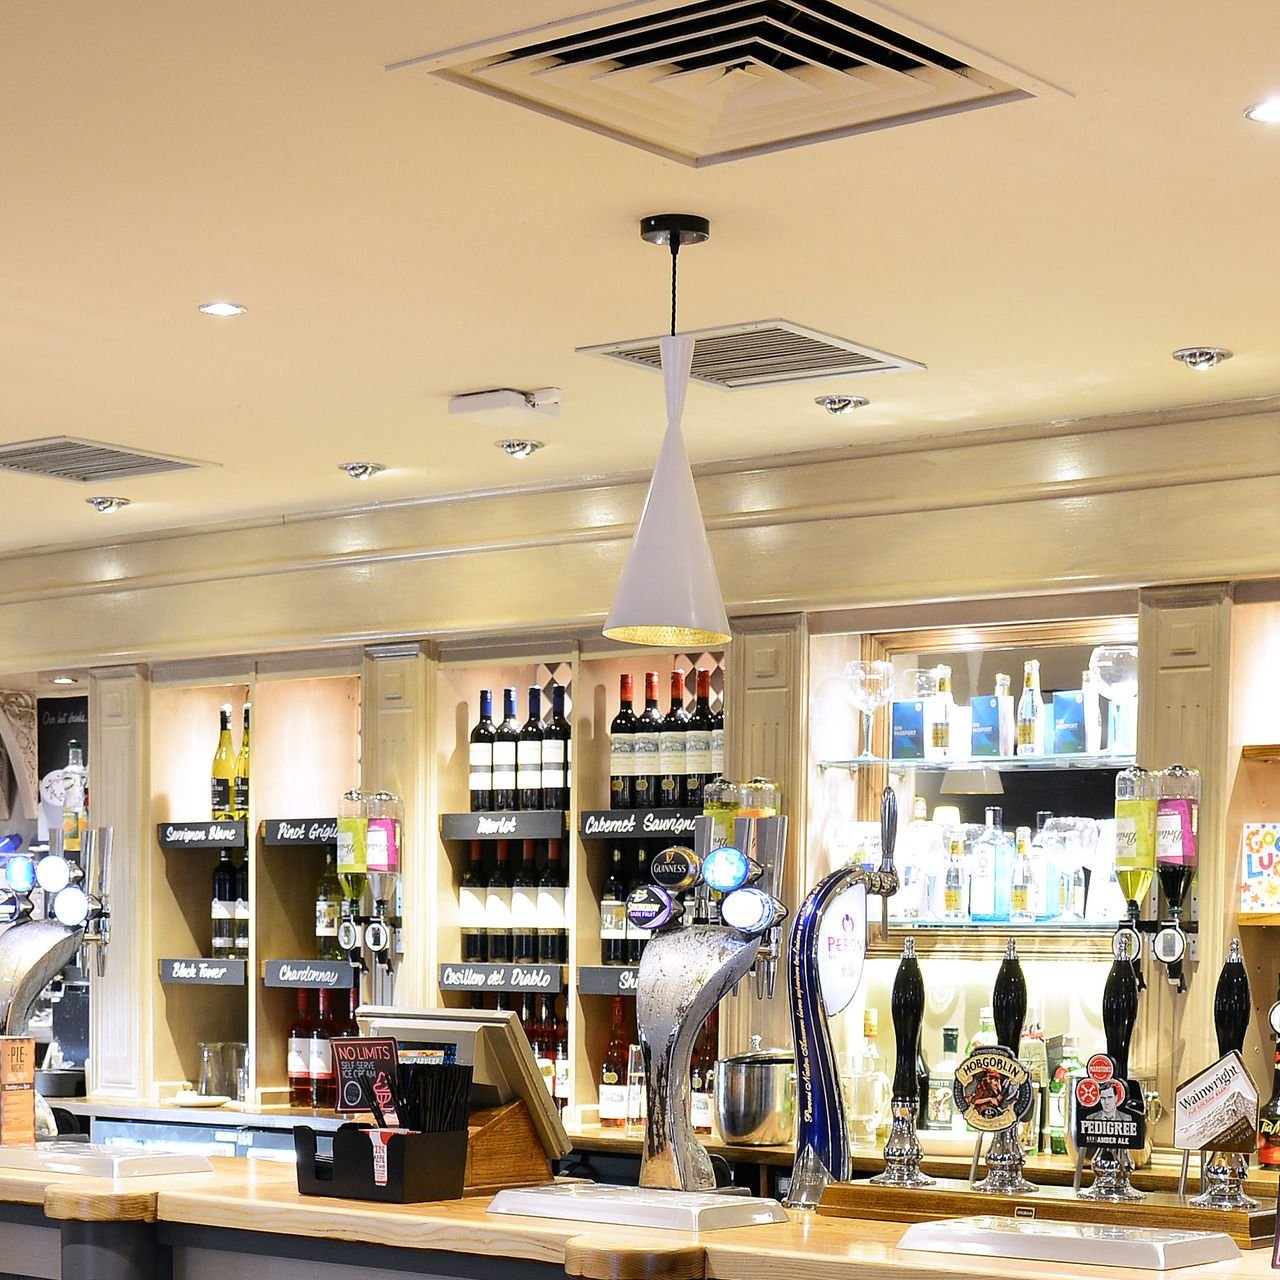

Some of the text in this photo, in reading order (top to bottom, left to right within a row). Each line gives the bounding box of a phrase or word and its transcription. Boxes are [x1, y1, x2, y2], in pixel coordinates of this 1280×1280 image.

[276, 821, 306, 840] Pinot
[476, 816, 517, 835] Merlot
[585, 813, 696, 836] Cabernet Sauvigno
[166, 825, 236, 843] Sauvignon Blanc
[653, 862, 687, 874] GUINNESS
[172, 961, 227, 979] Black Tower
[279, 964, 338, 984] Chardonnay
[487, 968, 506, 987] del
[510, 968, 552, 988] Diablo
[619, 974, 638, 990] Shi
[338, 1045, 391, 1060] NO LIMITS
[341, 1061, 376, 1070] SELF SERVE
[962, 1057, 1020, 1078] HOBGOBLIN
[341, 1070, 353, 1079] ICE
[1178, 1063, 1241, 1111] Wainwright
[1080, 1121, 1138, 1136] PEDIGREE
[1260, 1119, 1273, 1132] Tia
[1097, 1136, 1117, 1144] AMBER
[1117, 1136, 1130, 1145] ALE
[374, 1145, 385, 1154] IN
